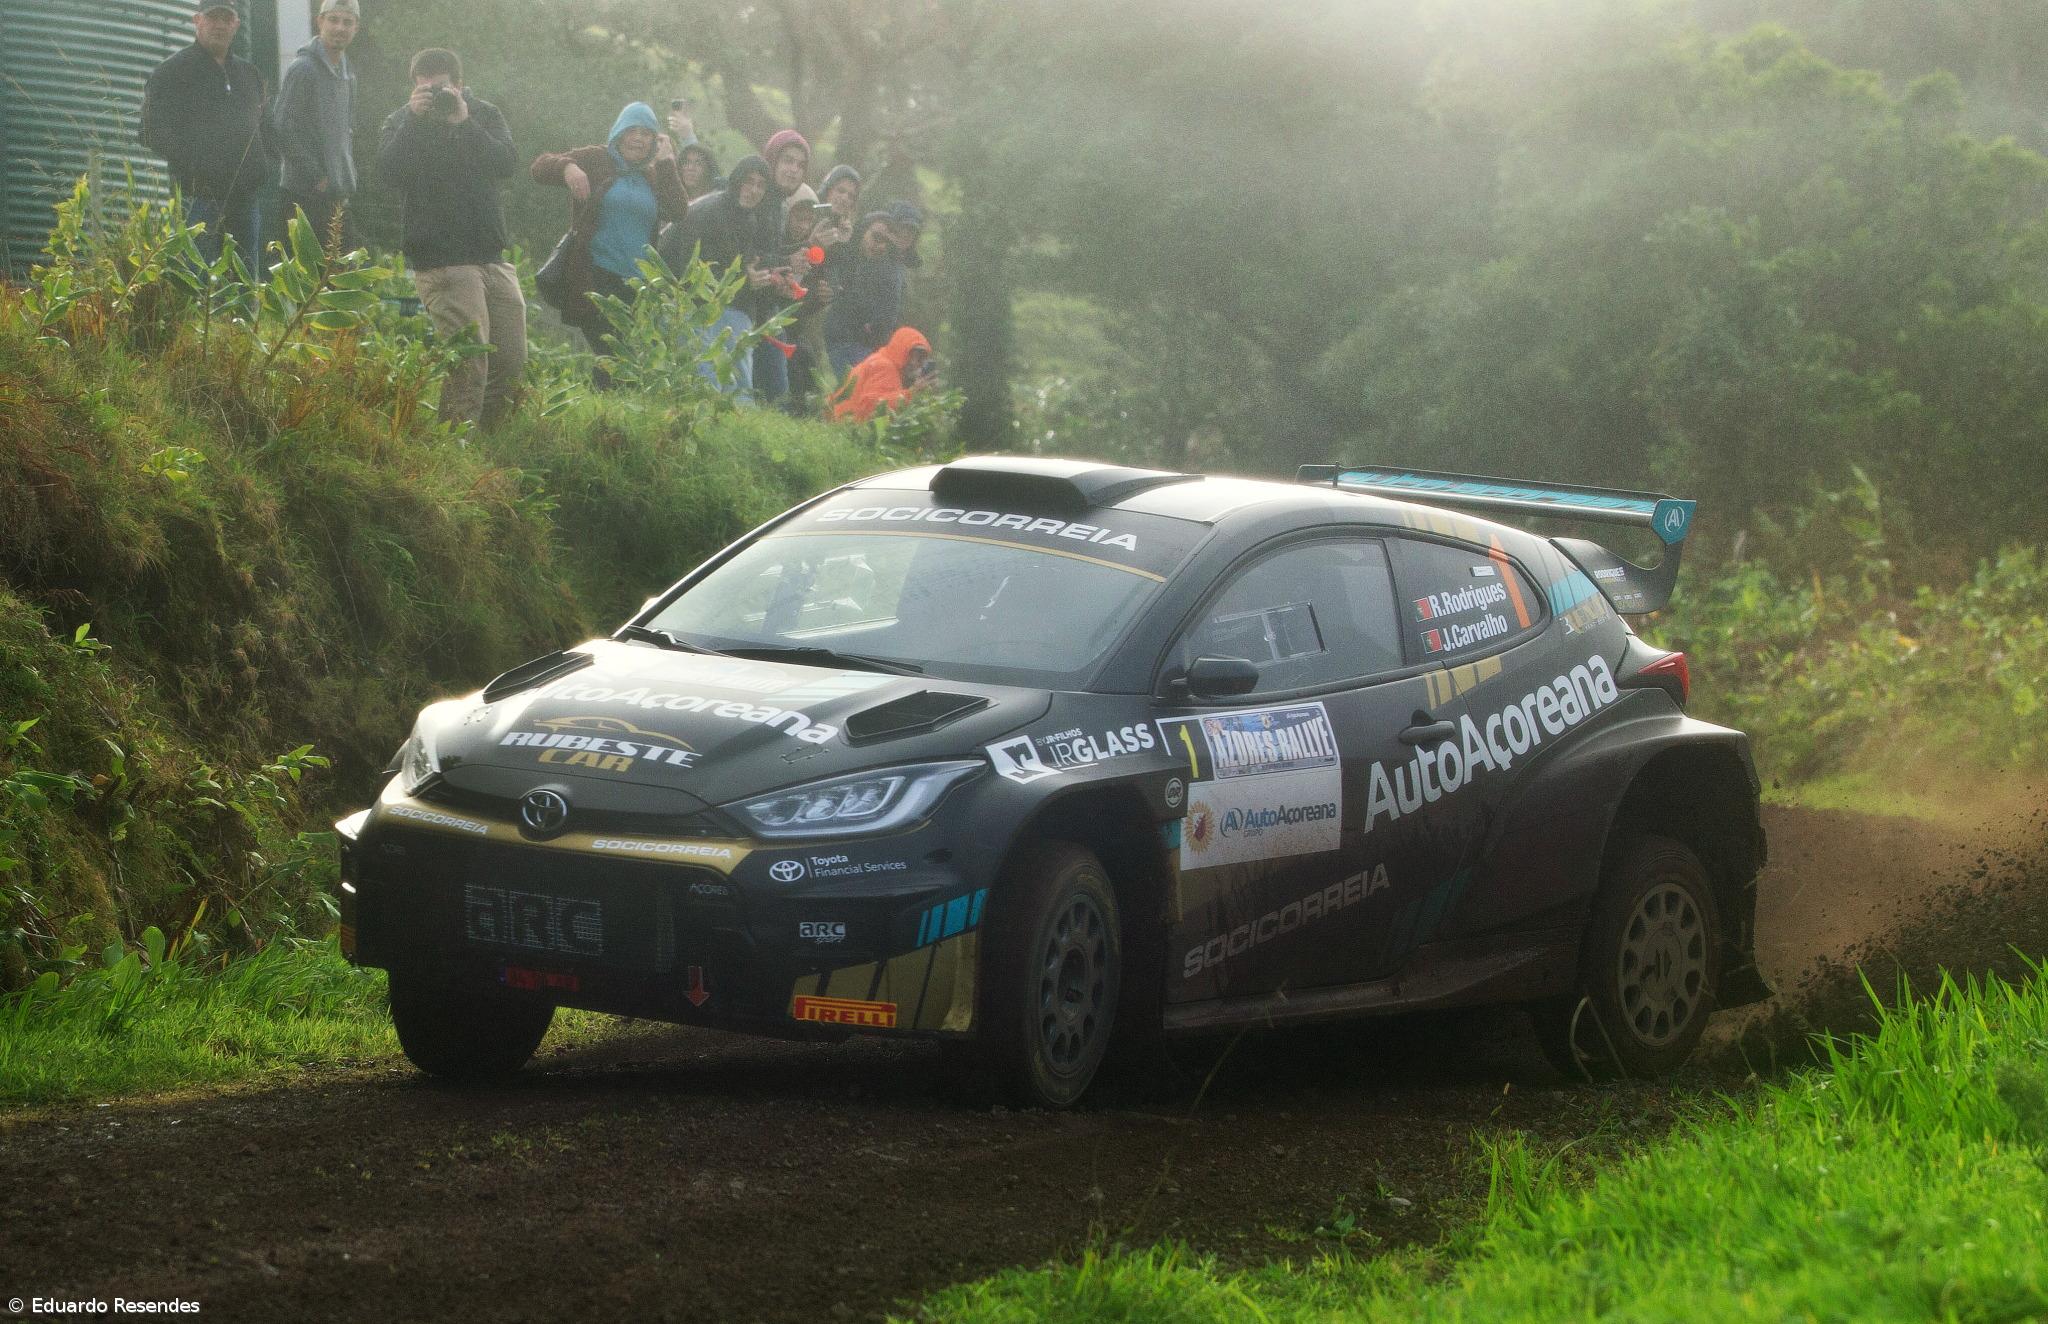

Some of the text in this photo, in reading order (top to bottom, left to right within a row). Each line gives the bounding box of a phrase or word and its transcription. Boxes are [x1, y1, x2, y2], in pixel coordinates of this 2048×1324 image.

[816, 507, 1137, 551] SOCICORREIA
[1428, 583, 1506, 617] R.Rodrigues
[1443, 614, 1508, 652] J.Carvalho
[545, 684, 838, 744] toAçoreana
[499, 732, 702, 769] RUBESTE
[538, 749, 634, 772] CAR
[1179, 724, 1199, 778] 1
[1364, 655, 1619, 834] AutoAçoreana
[389, 806, 489, 835] SOCICORREIA
[1244, 802, 1337, 830] AutoAçoreana
[592, 839, 733, 859] SOCICORREIA
[810, 854, 849, 867] Toyota
[814, 860, 907, 878] Financial Services
[1183, 862, 1391, 979] SOCICORREIA
[794, 996, 897, 1026] PIRELLI
